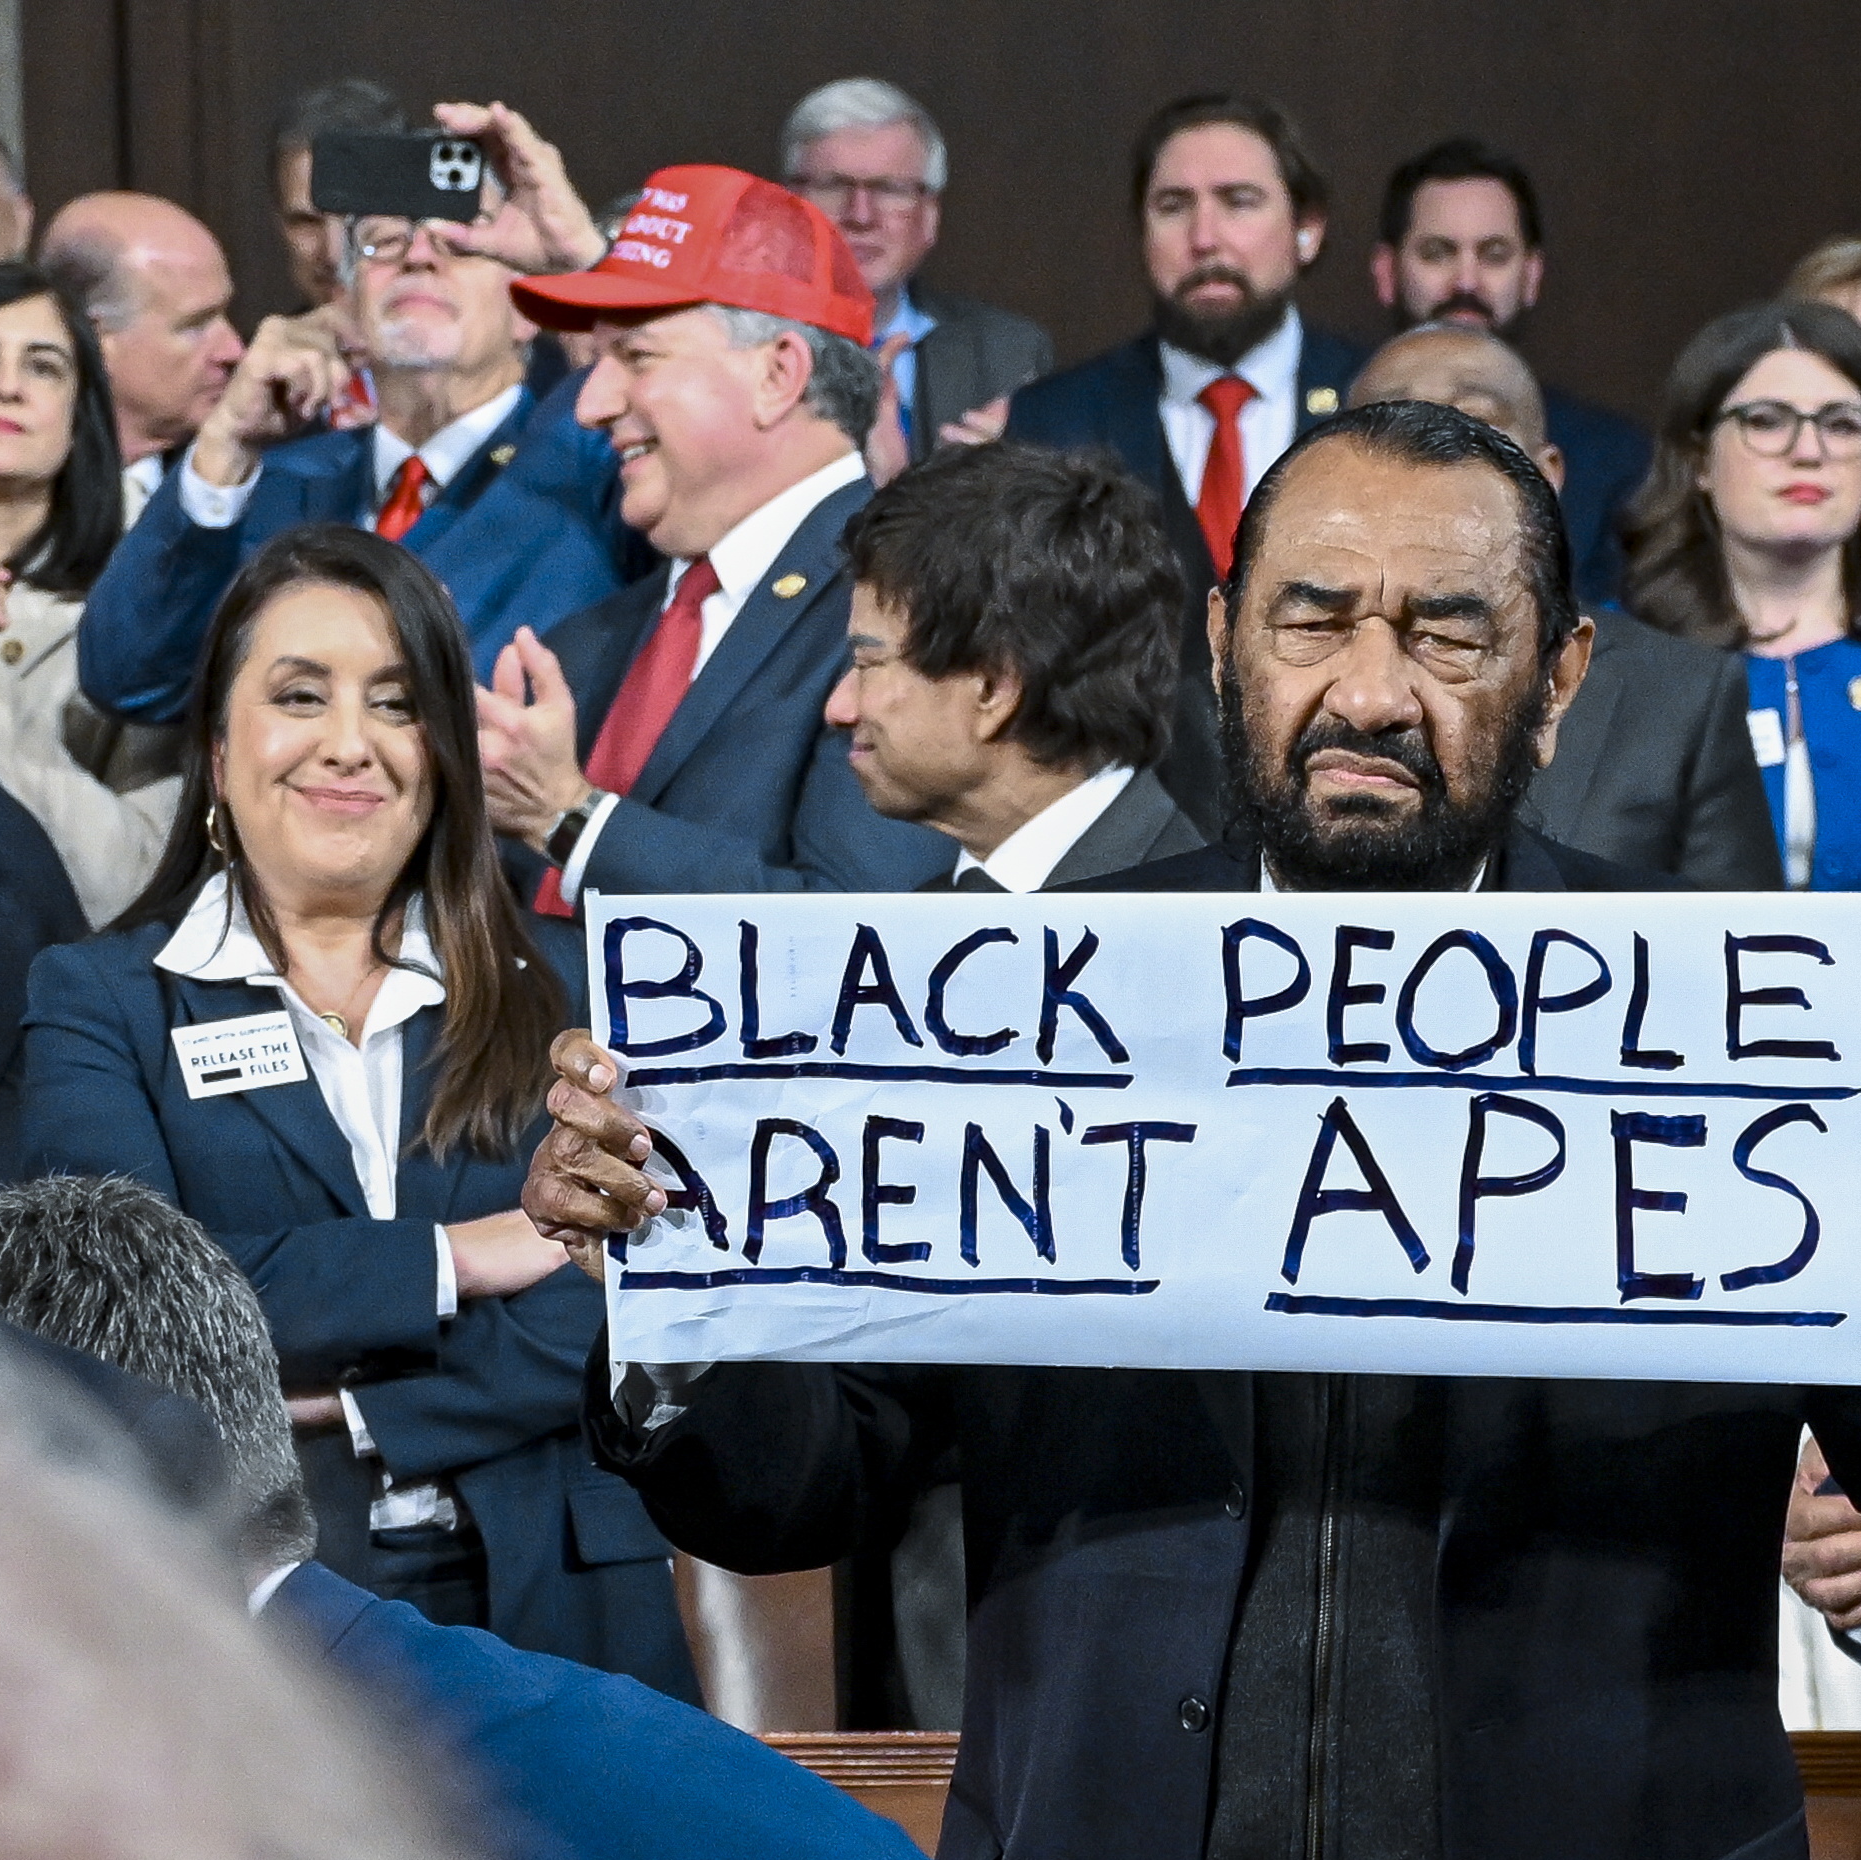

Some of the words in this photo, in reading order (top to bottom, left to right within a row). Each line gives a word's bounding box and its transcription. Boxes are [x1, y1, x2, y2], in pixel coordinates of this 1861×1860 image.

[603, 916, 1130, 1066] BLACK
[1221, 917, 1841, 1076] PEOPLE
[190, 1047, 256, 1067] RELEASE
[261, 1041, 291, 1057] THE
[249, 1059, 290, 1076] FILES
